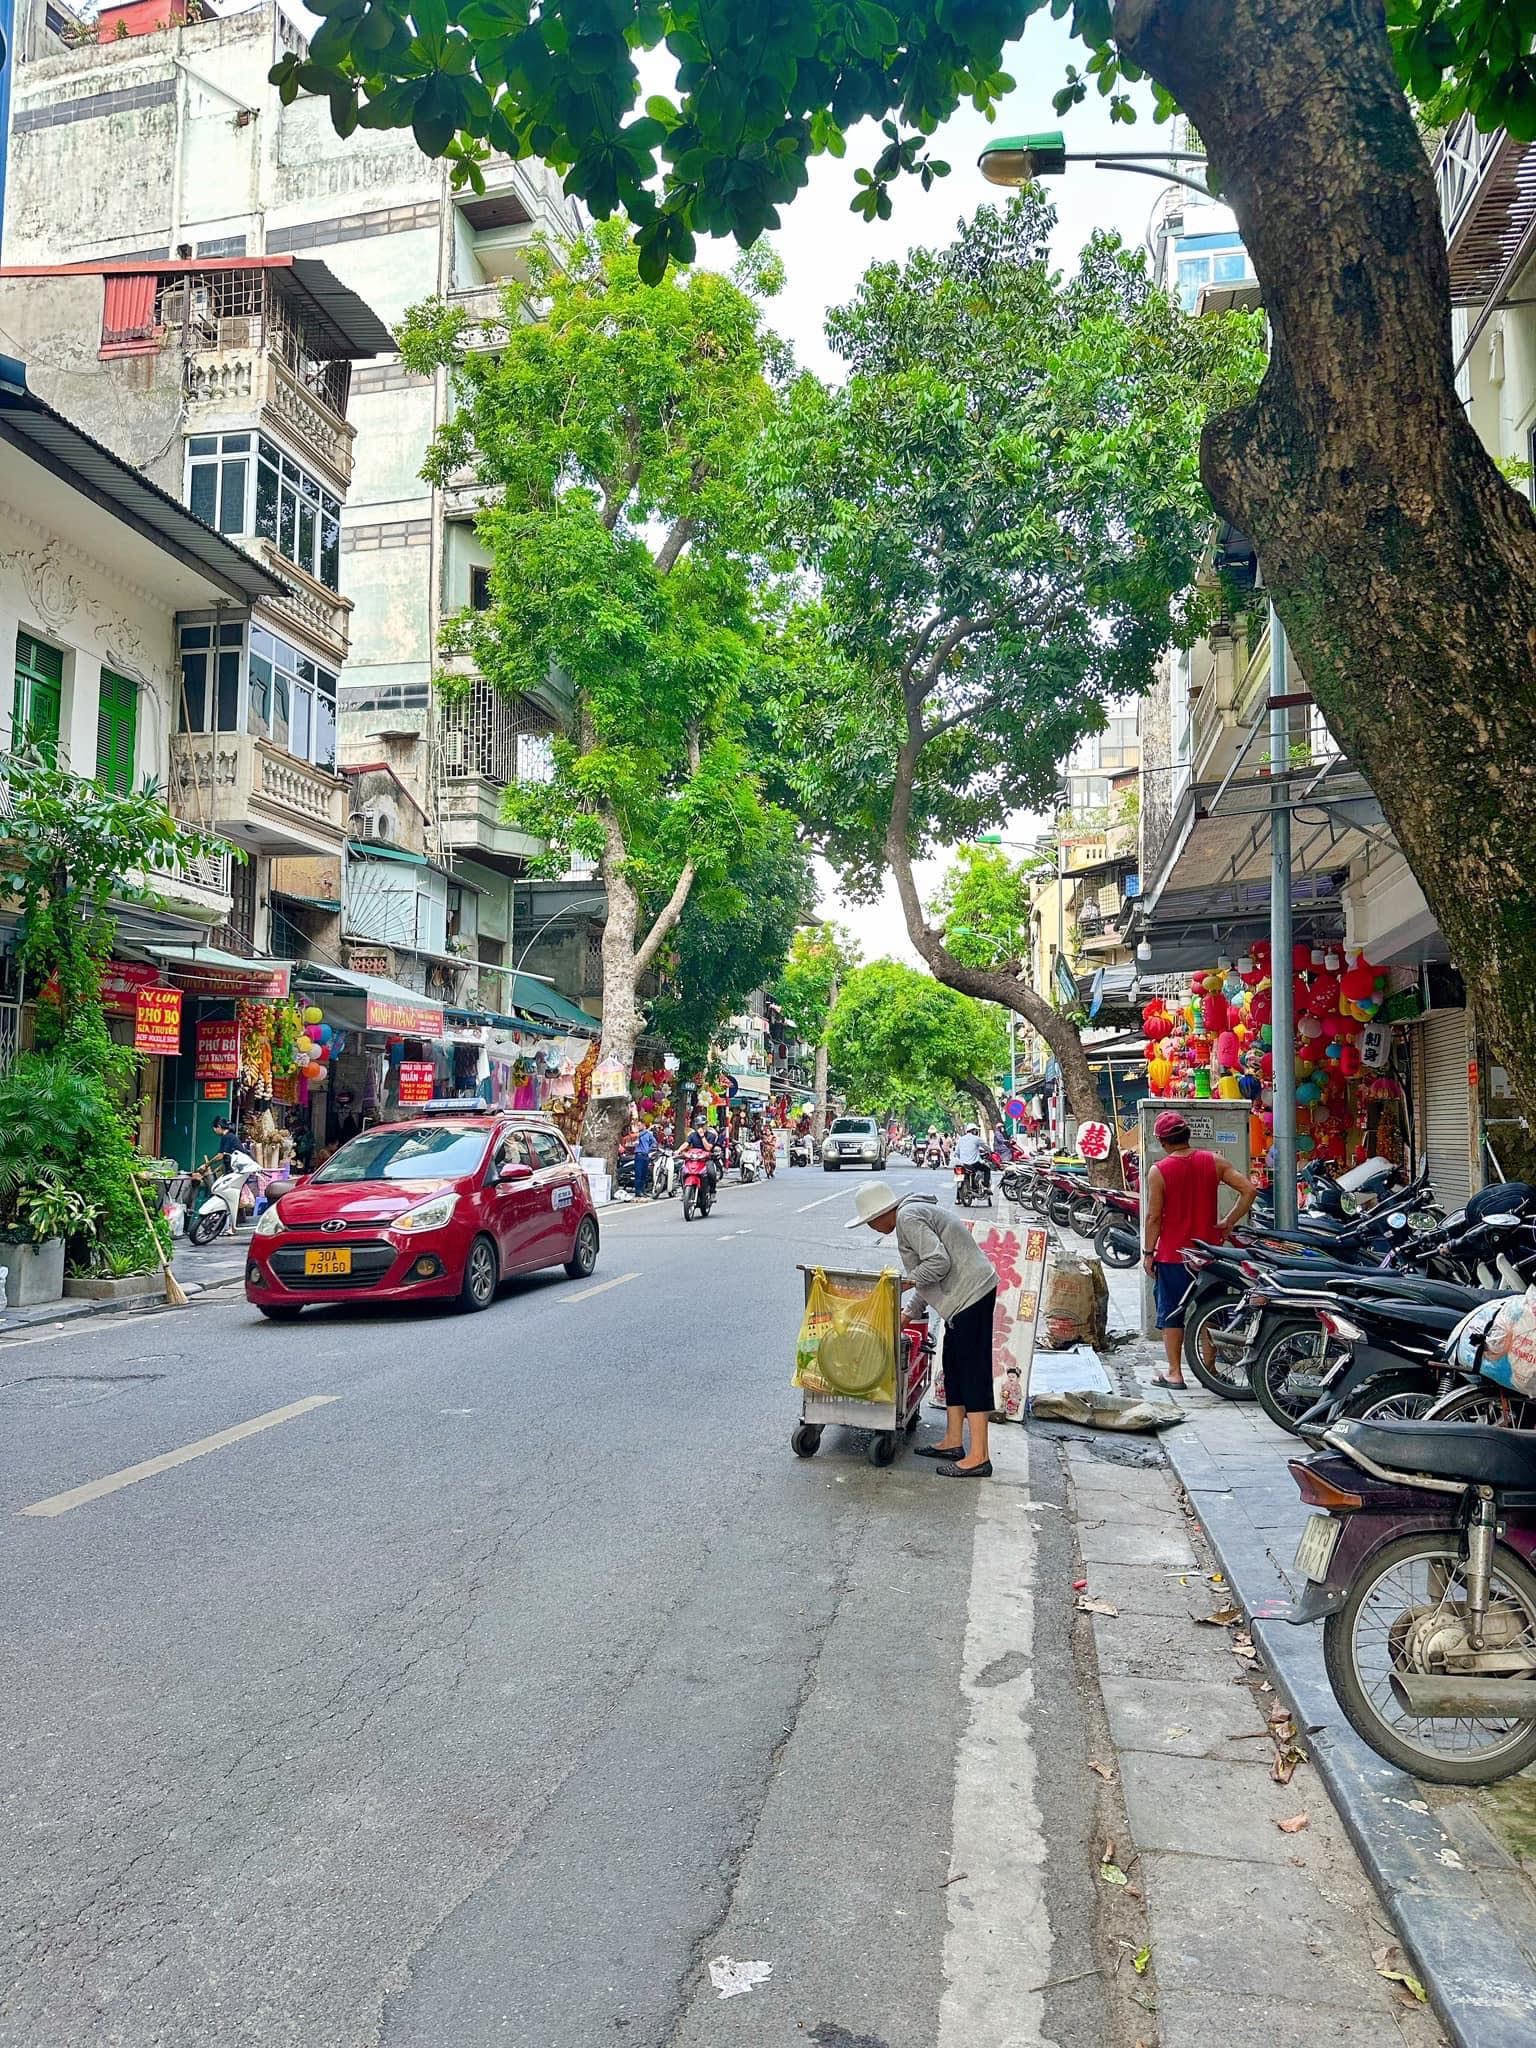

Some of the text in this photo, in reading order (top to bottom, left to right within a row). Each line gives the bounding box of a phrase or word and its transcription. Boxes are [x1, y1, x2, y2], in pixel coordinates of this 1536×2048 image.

[370, 1005, 391, 1026] MINH
[393, 1009, 417, 1029] TRANG
[423, 1072, 432, 1082] ÁO
[318, 1250, 337, 1262] 30A
[310, 1261, 346, 1273] 791.60
